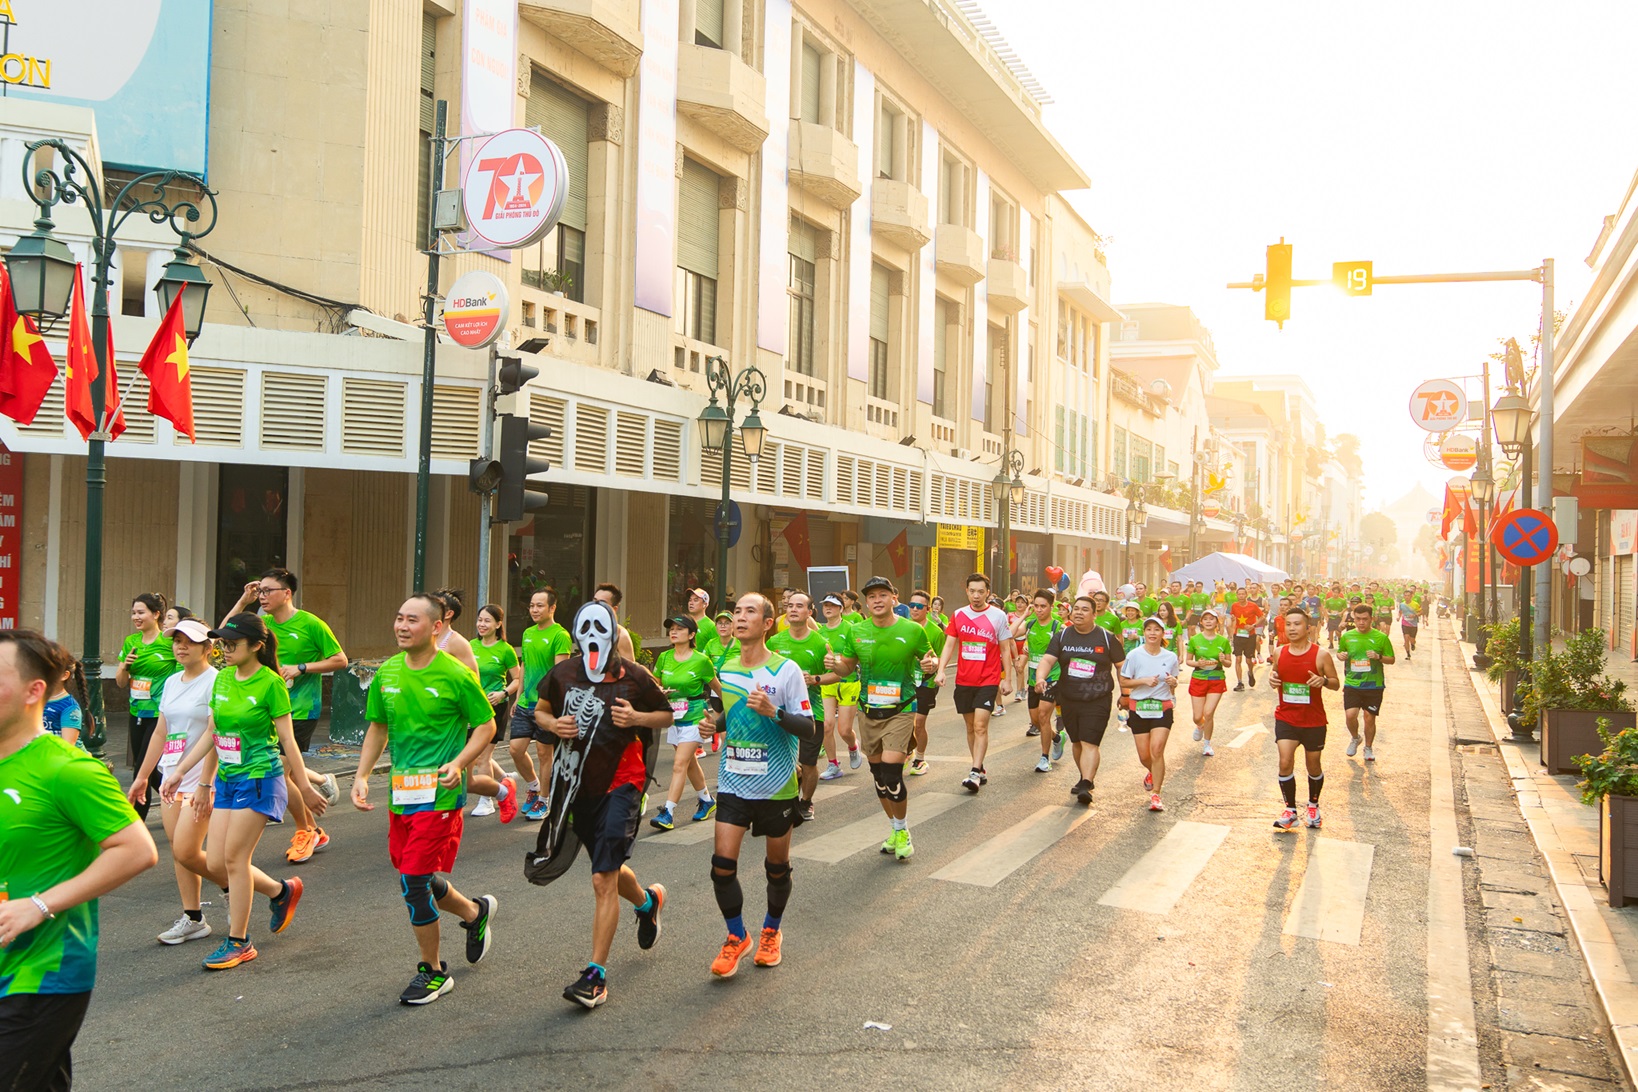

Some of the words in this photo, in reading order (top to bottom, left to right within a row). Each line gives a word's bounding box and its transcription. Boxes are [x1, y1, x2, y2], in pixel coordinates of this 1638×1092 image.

[478, 152, 545, 220] 70
[1347, 268, 1367, 291] 19
[452, 297, 487, 308] HDBank
[1417, 390, 1459, 421] 70
[960, 624, 977, 635] AIA
[735, 747, 762, 759] 90623
